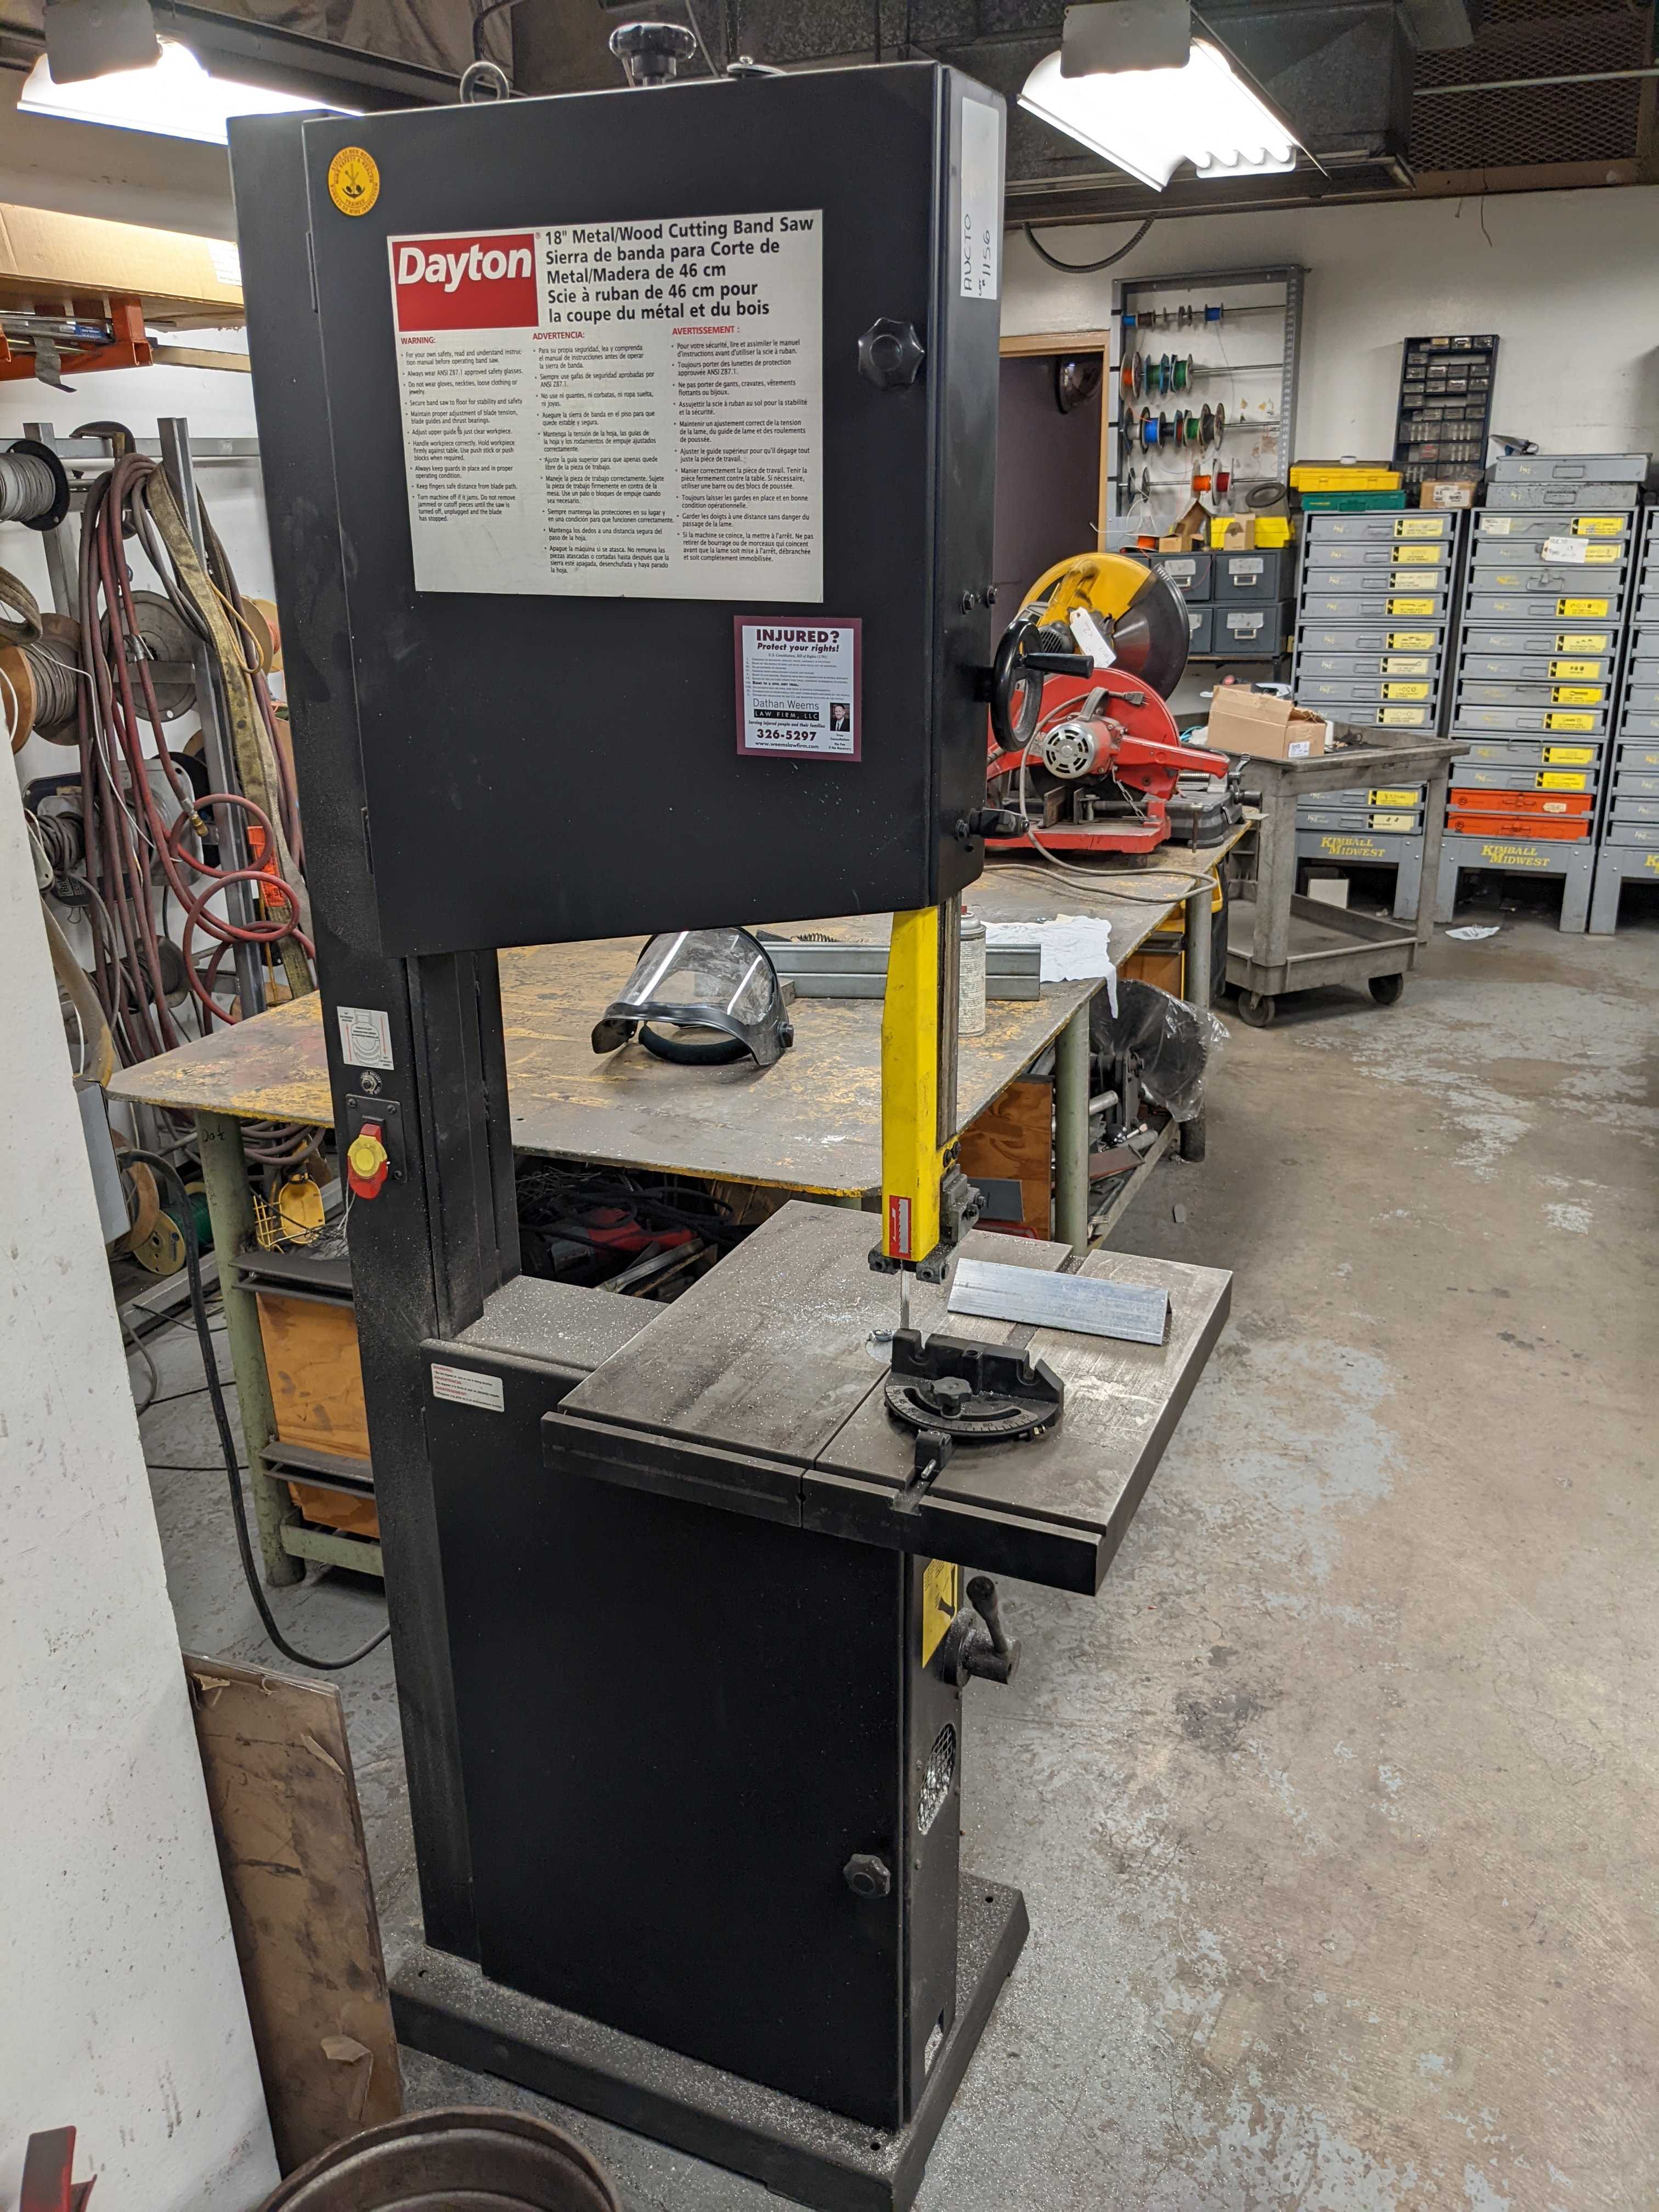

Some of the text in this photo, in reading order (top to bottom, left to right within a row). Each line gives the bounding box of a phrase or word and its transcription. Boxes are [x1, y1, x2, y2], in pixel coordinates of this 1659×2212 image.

[545, 216, 814, 245] 18" Metal/Wood Cutting Band Saw
[546, 237, 780, 265] Sierra de banda para Corte de
[398, 244, 532, 292] Dayton
[547, 263, 726, 284] Metal/Madera de 46 cm
[548, 283, 758, 303] Scie à ruban de 46 cm pour
[549, 299, 769, 325] la coupe du métal et du bois
[532, 331, 585, 340] ADVERTENCIA:
[672, 326, 735, 335] AVERTISSEMENT
[574, 345, 600, 354] seguridad,
[614, 344, 643, 352] comprenda
[464, 368, 487, 376] approved
[503, 368, 523, 376] glasses.
[757, 629, 839, 643] INJURED?
[811, 645, 839, 653] rights!
[753, 698, 819, 710] Dathan Weems
[757, 729, 816, 741] 326-5297
[755, 741, 819, 749] www.weemslawfirm.com
[1321, 837, 1374, 847] KIMBALL
[1329, 844, 1386, 857] MIDWEST
[1481, 845, 1538, 856] KIMBALL
[1489, 854, 1550, 866] MIDWEST
